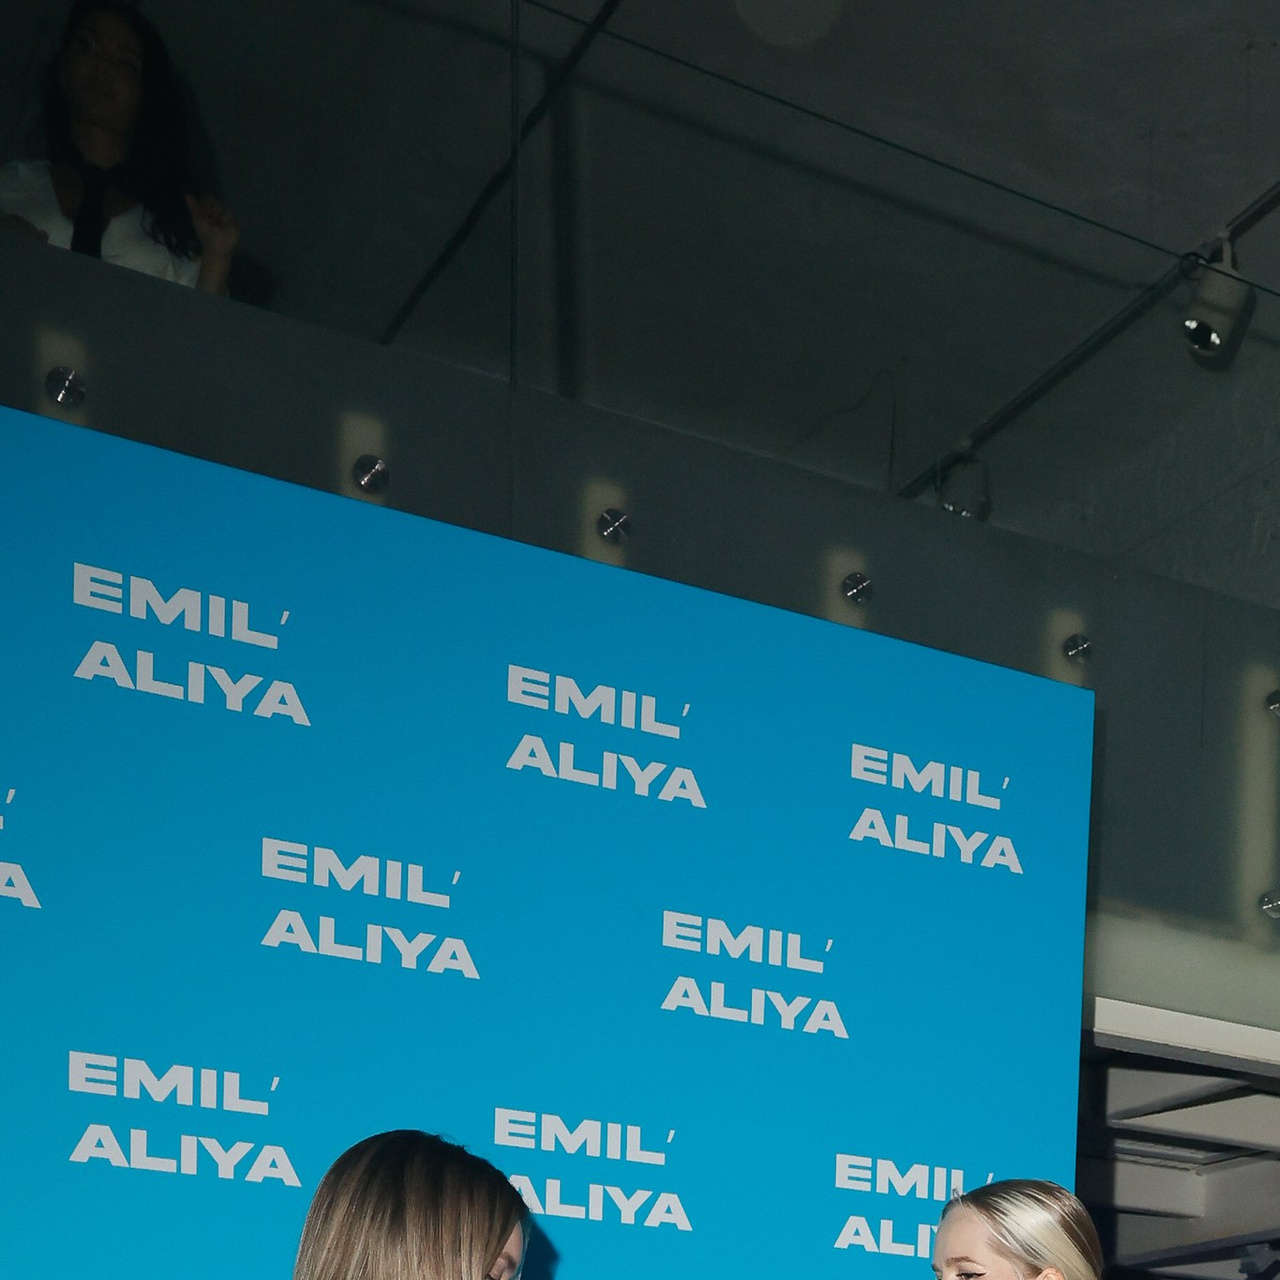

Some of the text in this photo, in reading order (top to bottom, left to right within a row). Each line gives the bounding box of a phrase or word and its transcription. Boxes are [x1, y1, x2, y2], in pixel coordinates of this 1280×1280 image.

[74, 642, 310, 726] ALIYA
[506, 735, 706, 808] ALIYA
[849, 808, 1023, 874] ALIYA
[261, 910, 480, 979] ALIYA
[661, 977, 849, 1038] ALIYA
[69, 1124, 301, 1187] ALIYA
[834, 1216, 939, 1258] ALI
